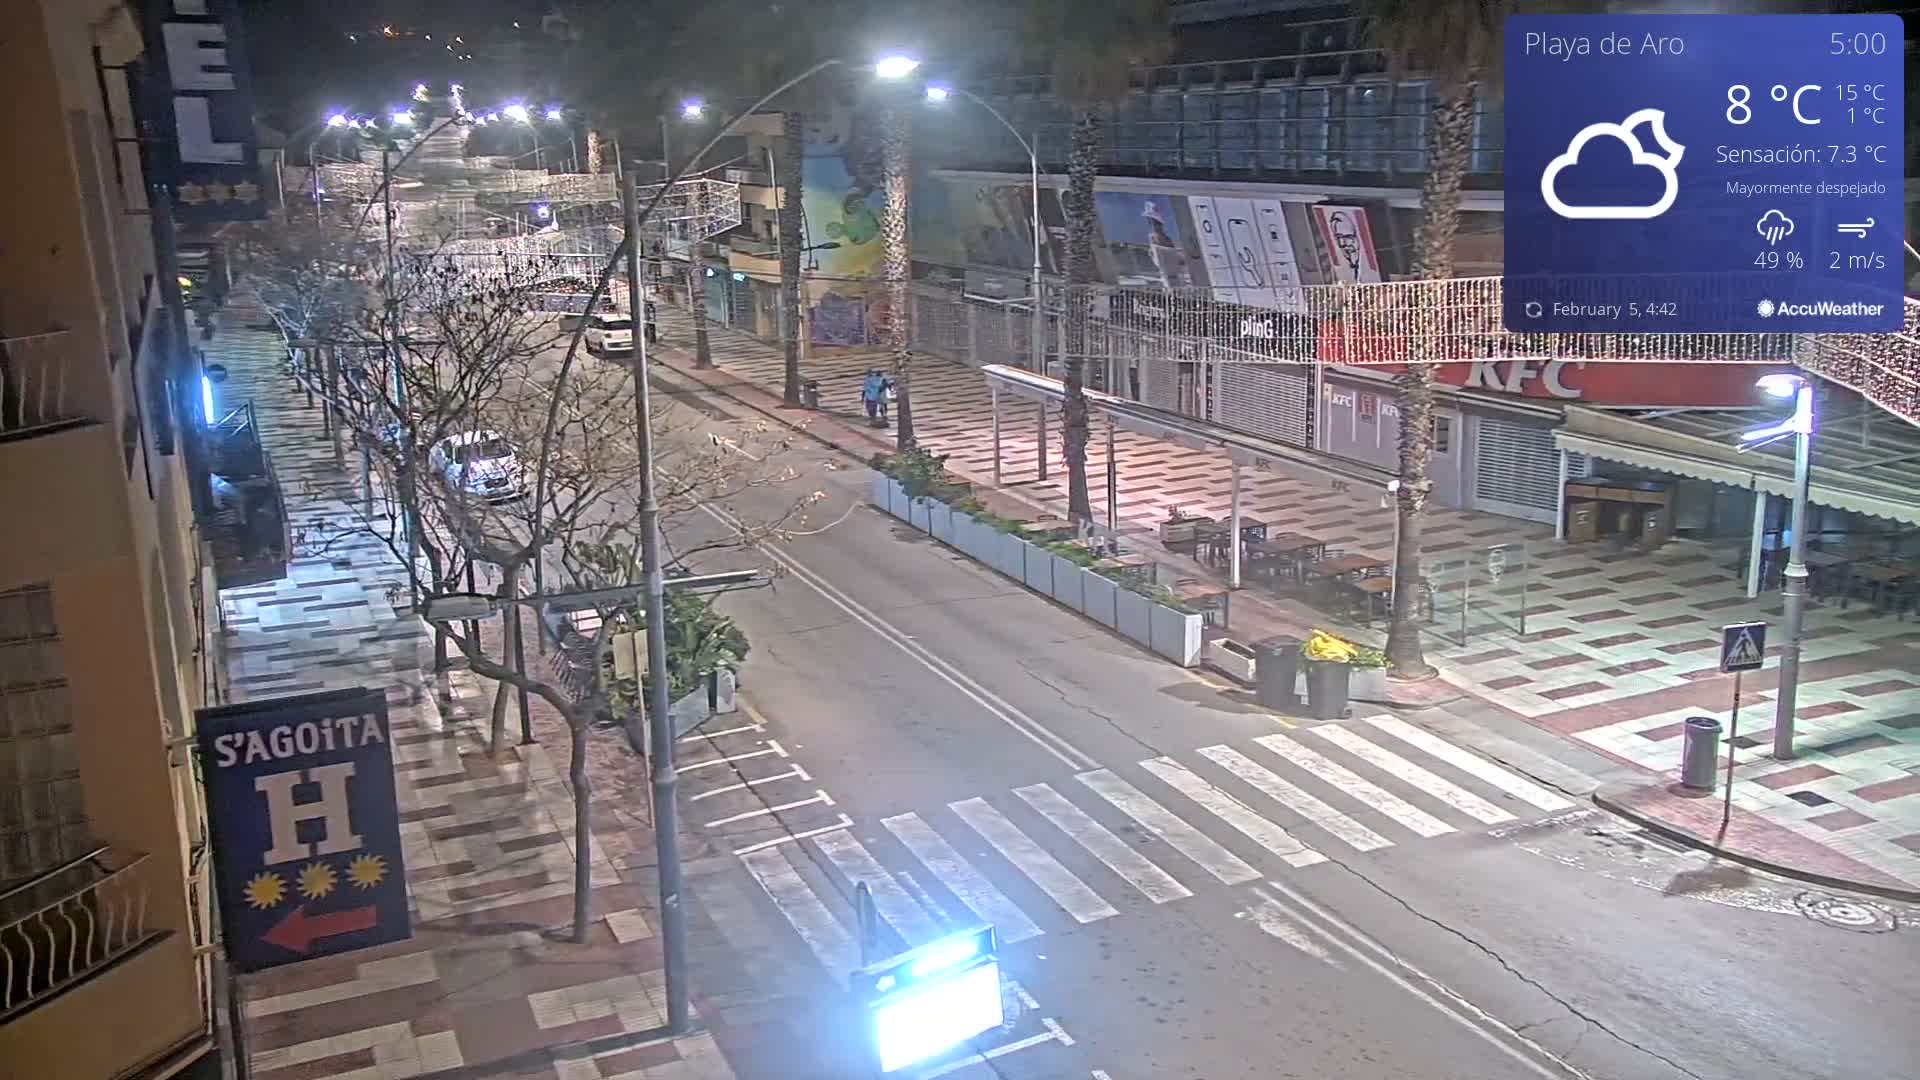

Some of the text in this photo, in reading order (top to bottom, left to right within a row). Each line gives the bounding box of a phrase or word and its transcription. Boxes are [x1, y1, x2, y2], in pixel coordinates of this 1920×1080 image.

[162, 0, 247, 165] EL
[1332, 393, 1352, 407] KFC
[1465, 359, 1586, 398] KFC
[254, 761, 363, 866] H
